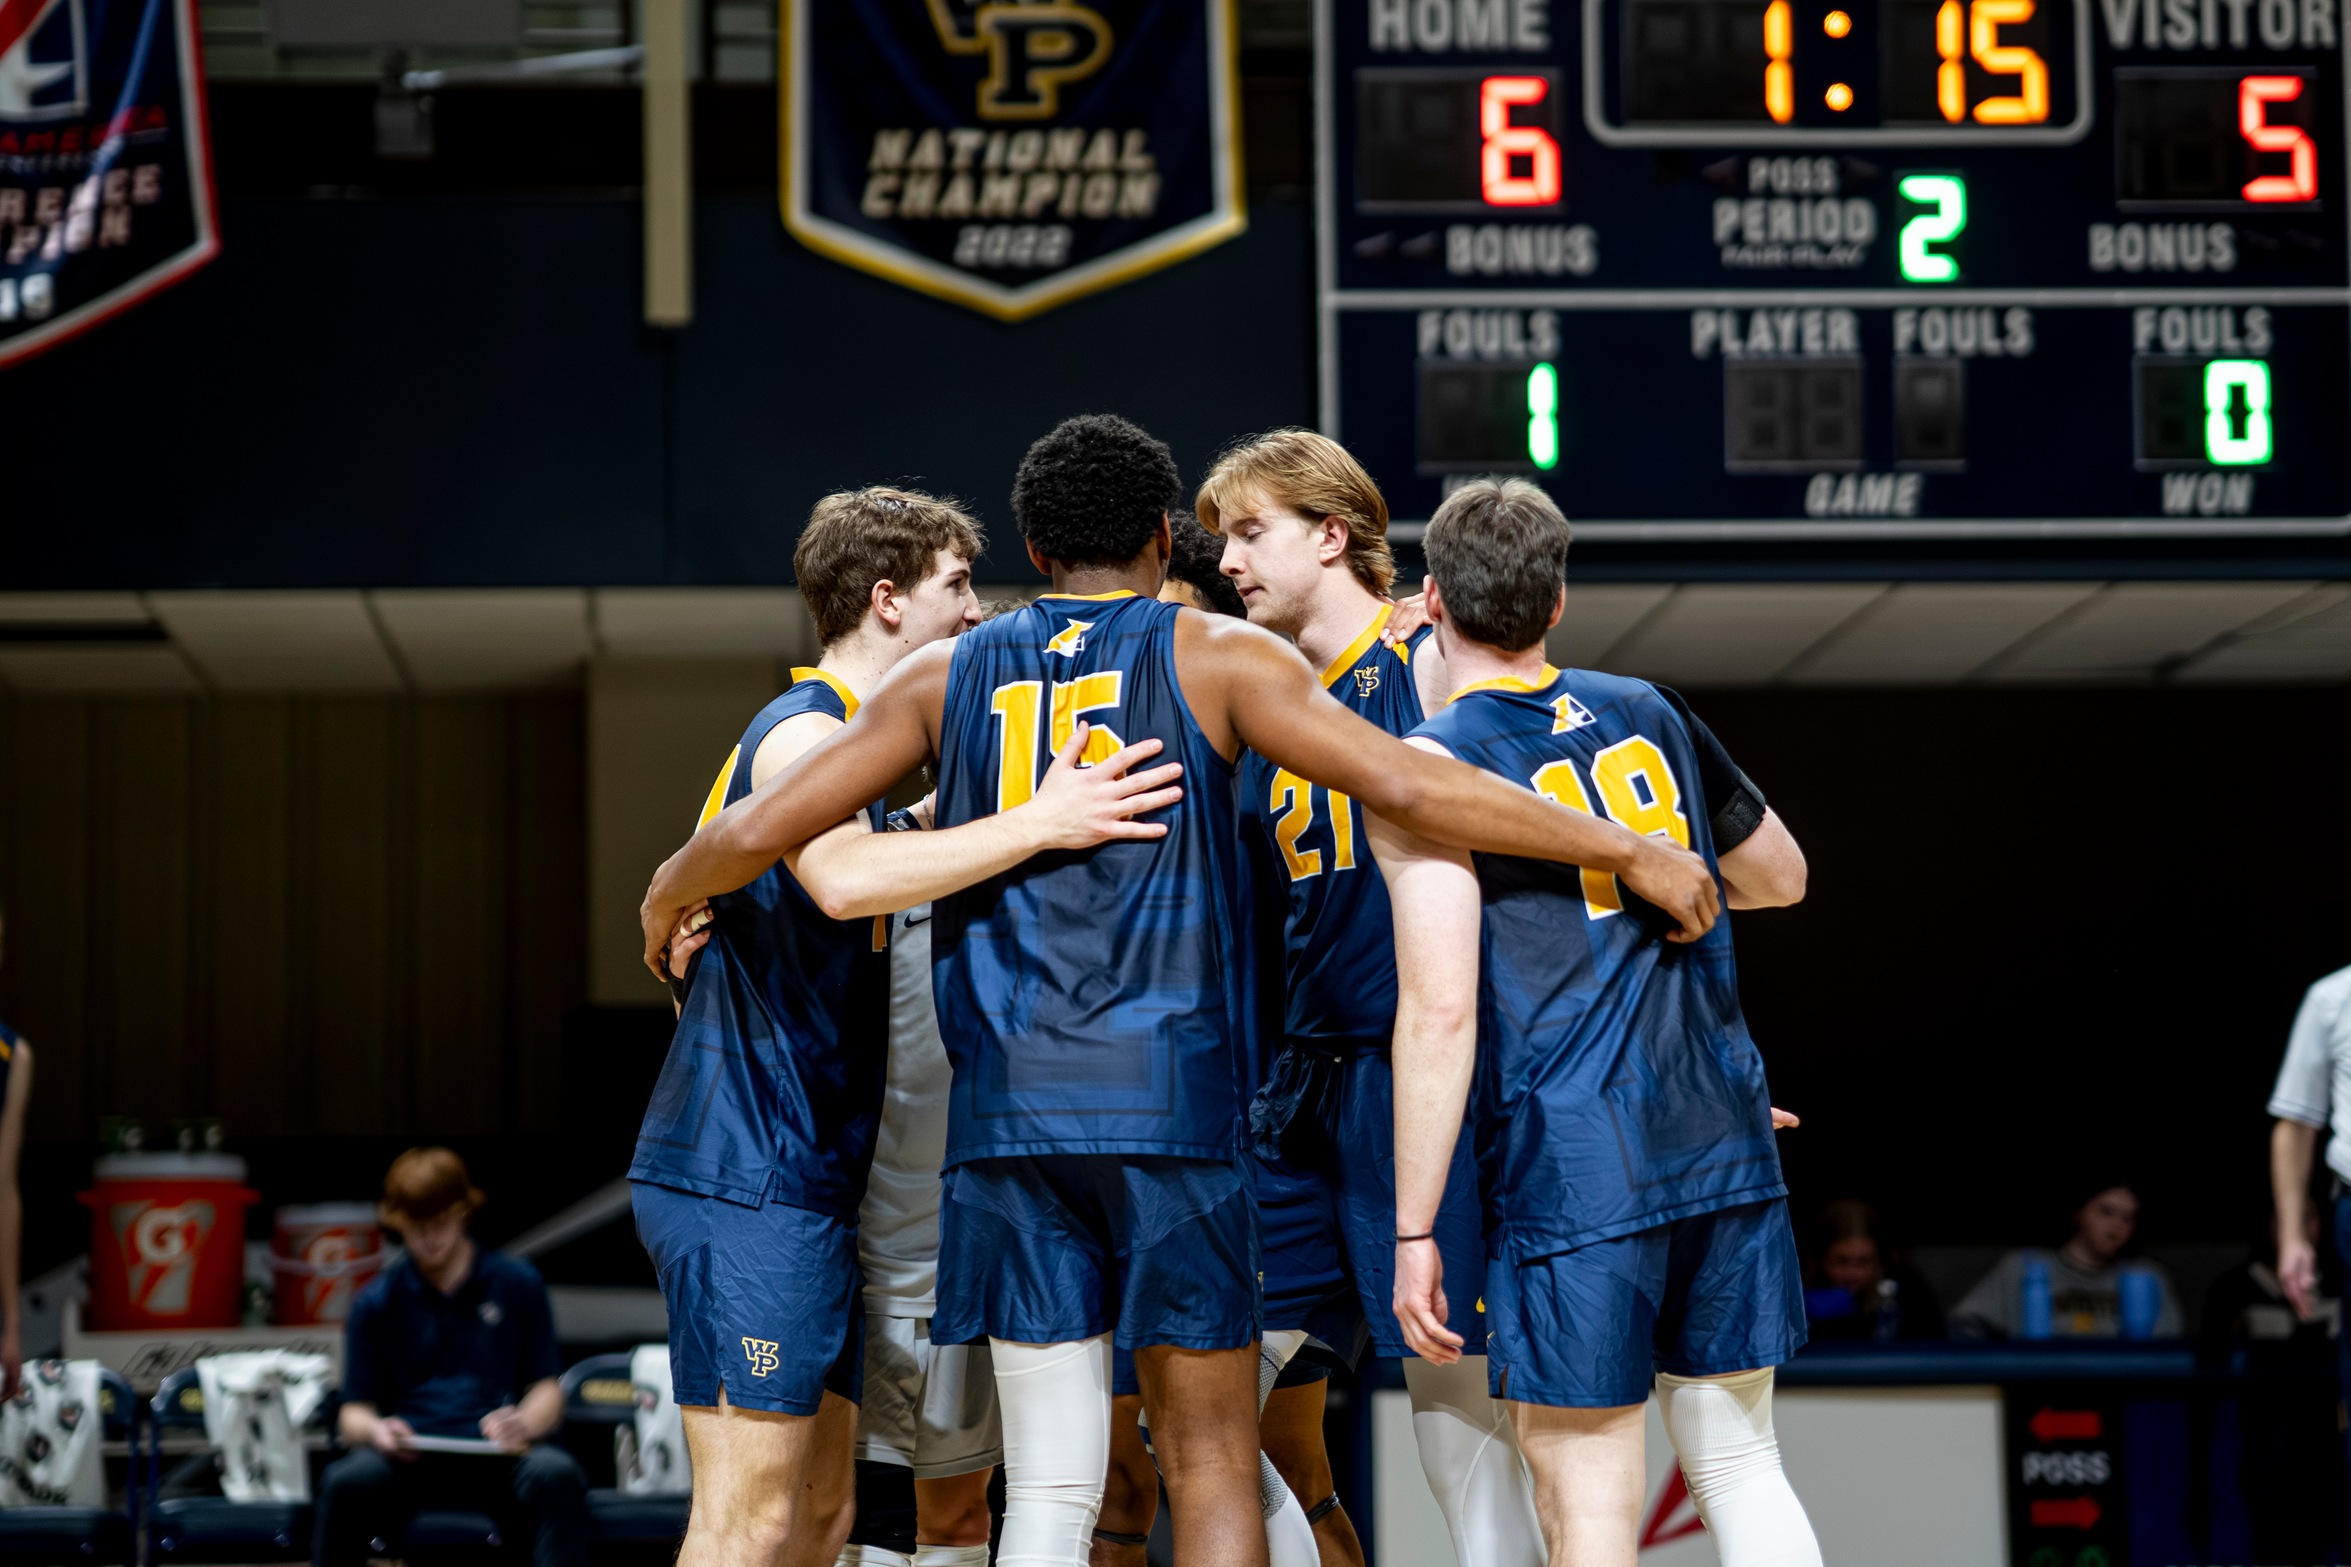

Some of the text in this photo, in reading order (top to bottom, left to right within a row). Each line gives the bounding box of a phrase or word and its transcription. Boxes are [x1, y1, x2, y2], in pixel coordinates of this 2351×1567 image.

[1369, 0, 1550, 51] HOME
[2103, 0, 2337, 50] VISITOR
[869, 128, 1156, 171] NATIONAL
[1480, 75, 1562, 207] 6
[2239, 75, 2318, 203] 5
[860, 172, 1162, 219] CHAMPION
[1747, 155, 1839, 195] POSS
[1713, 196, 1879, 246] PERIOD
[1899, 174, 1967, 283] 2
[1445, 225, 1598, 275] BONUS
[2089, 223, 2237, 273] BONUS
[1416, 309, 1560, 358] FOULS
[1691, 307, 2034, 358] PLAYER FOULS
[2133, 306, 2274, 357] FOULS
[1527, 361, 1559, 469] 1
[2203, 359, 2273, 466] 0
[1804, 472, 1923, 518] GAME
[2161, 472, 2255, 516] WON
[1353, 666, 1380, 698] WP
[990, 670, 1134, 826] 15
[1269, 767, 1357, 882] 21
[136, 1207, 187, 1264] G
[741, 1336, 780, 1378] WP
[2023, 1450, 2112, 1486] POSS
